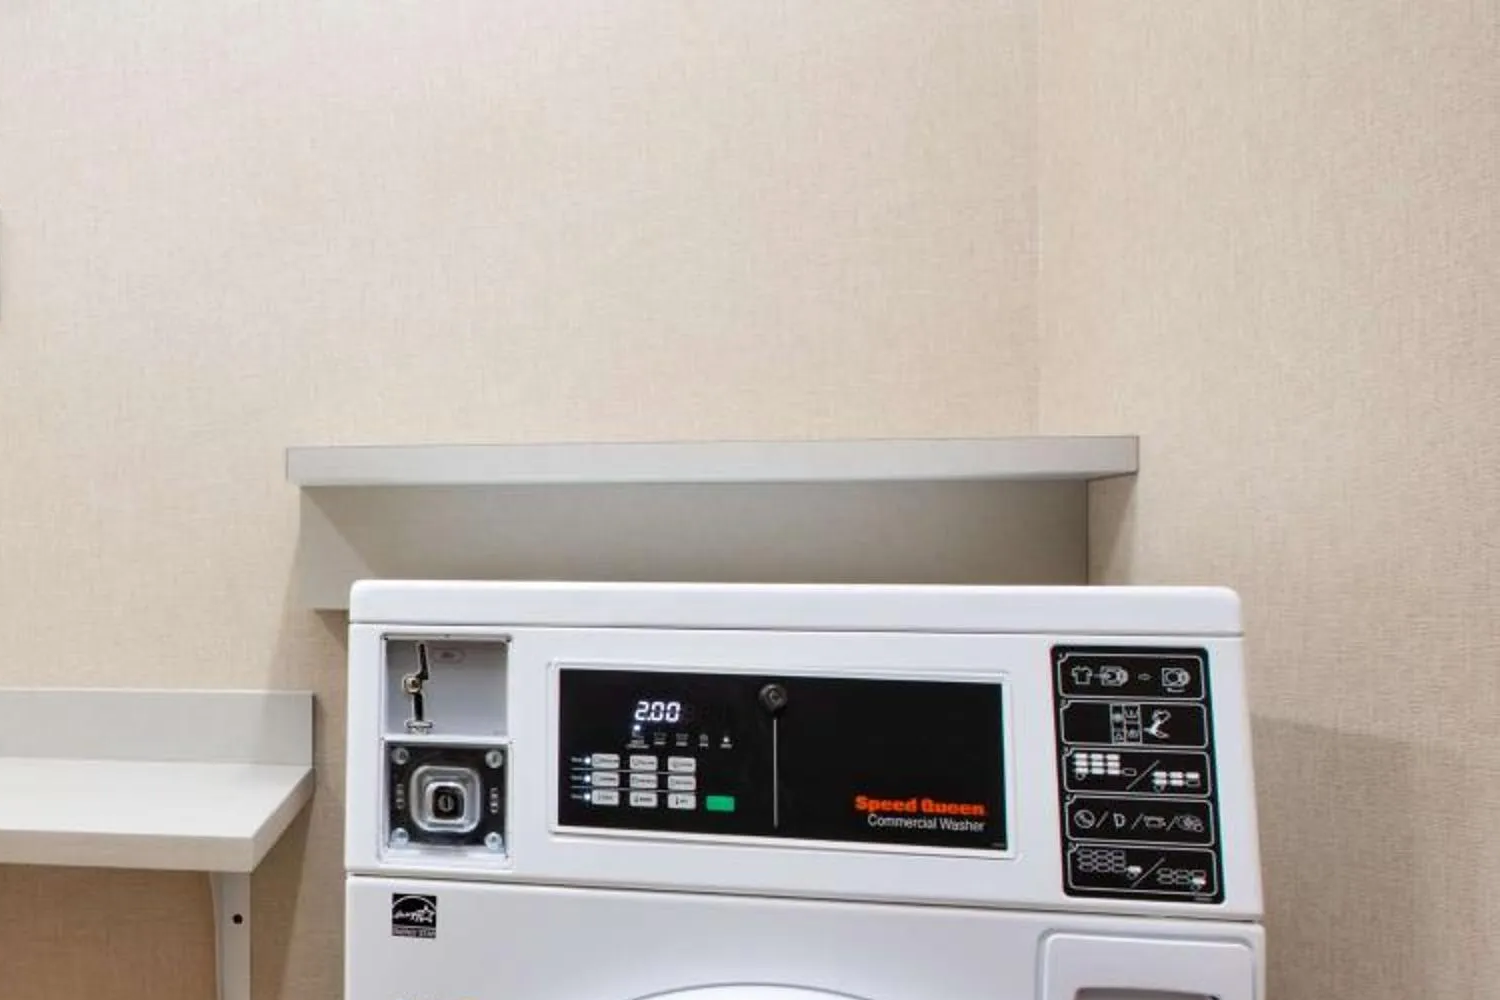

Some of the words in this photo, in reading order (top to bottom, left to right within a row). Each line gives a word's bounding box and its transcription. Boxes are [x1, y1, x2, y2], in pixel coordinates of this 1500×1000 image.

[634, 700, 681, 723] 2.00
[855, 795, 918, 813] Speed
[921, 798, 985, 815] Queen
[867, 813, 937, 830] Commercial
[939, 817, 986, 832] Washer
